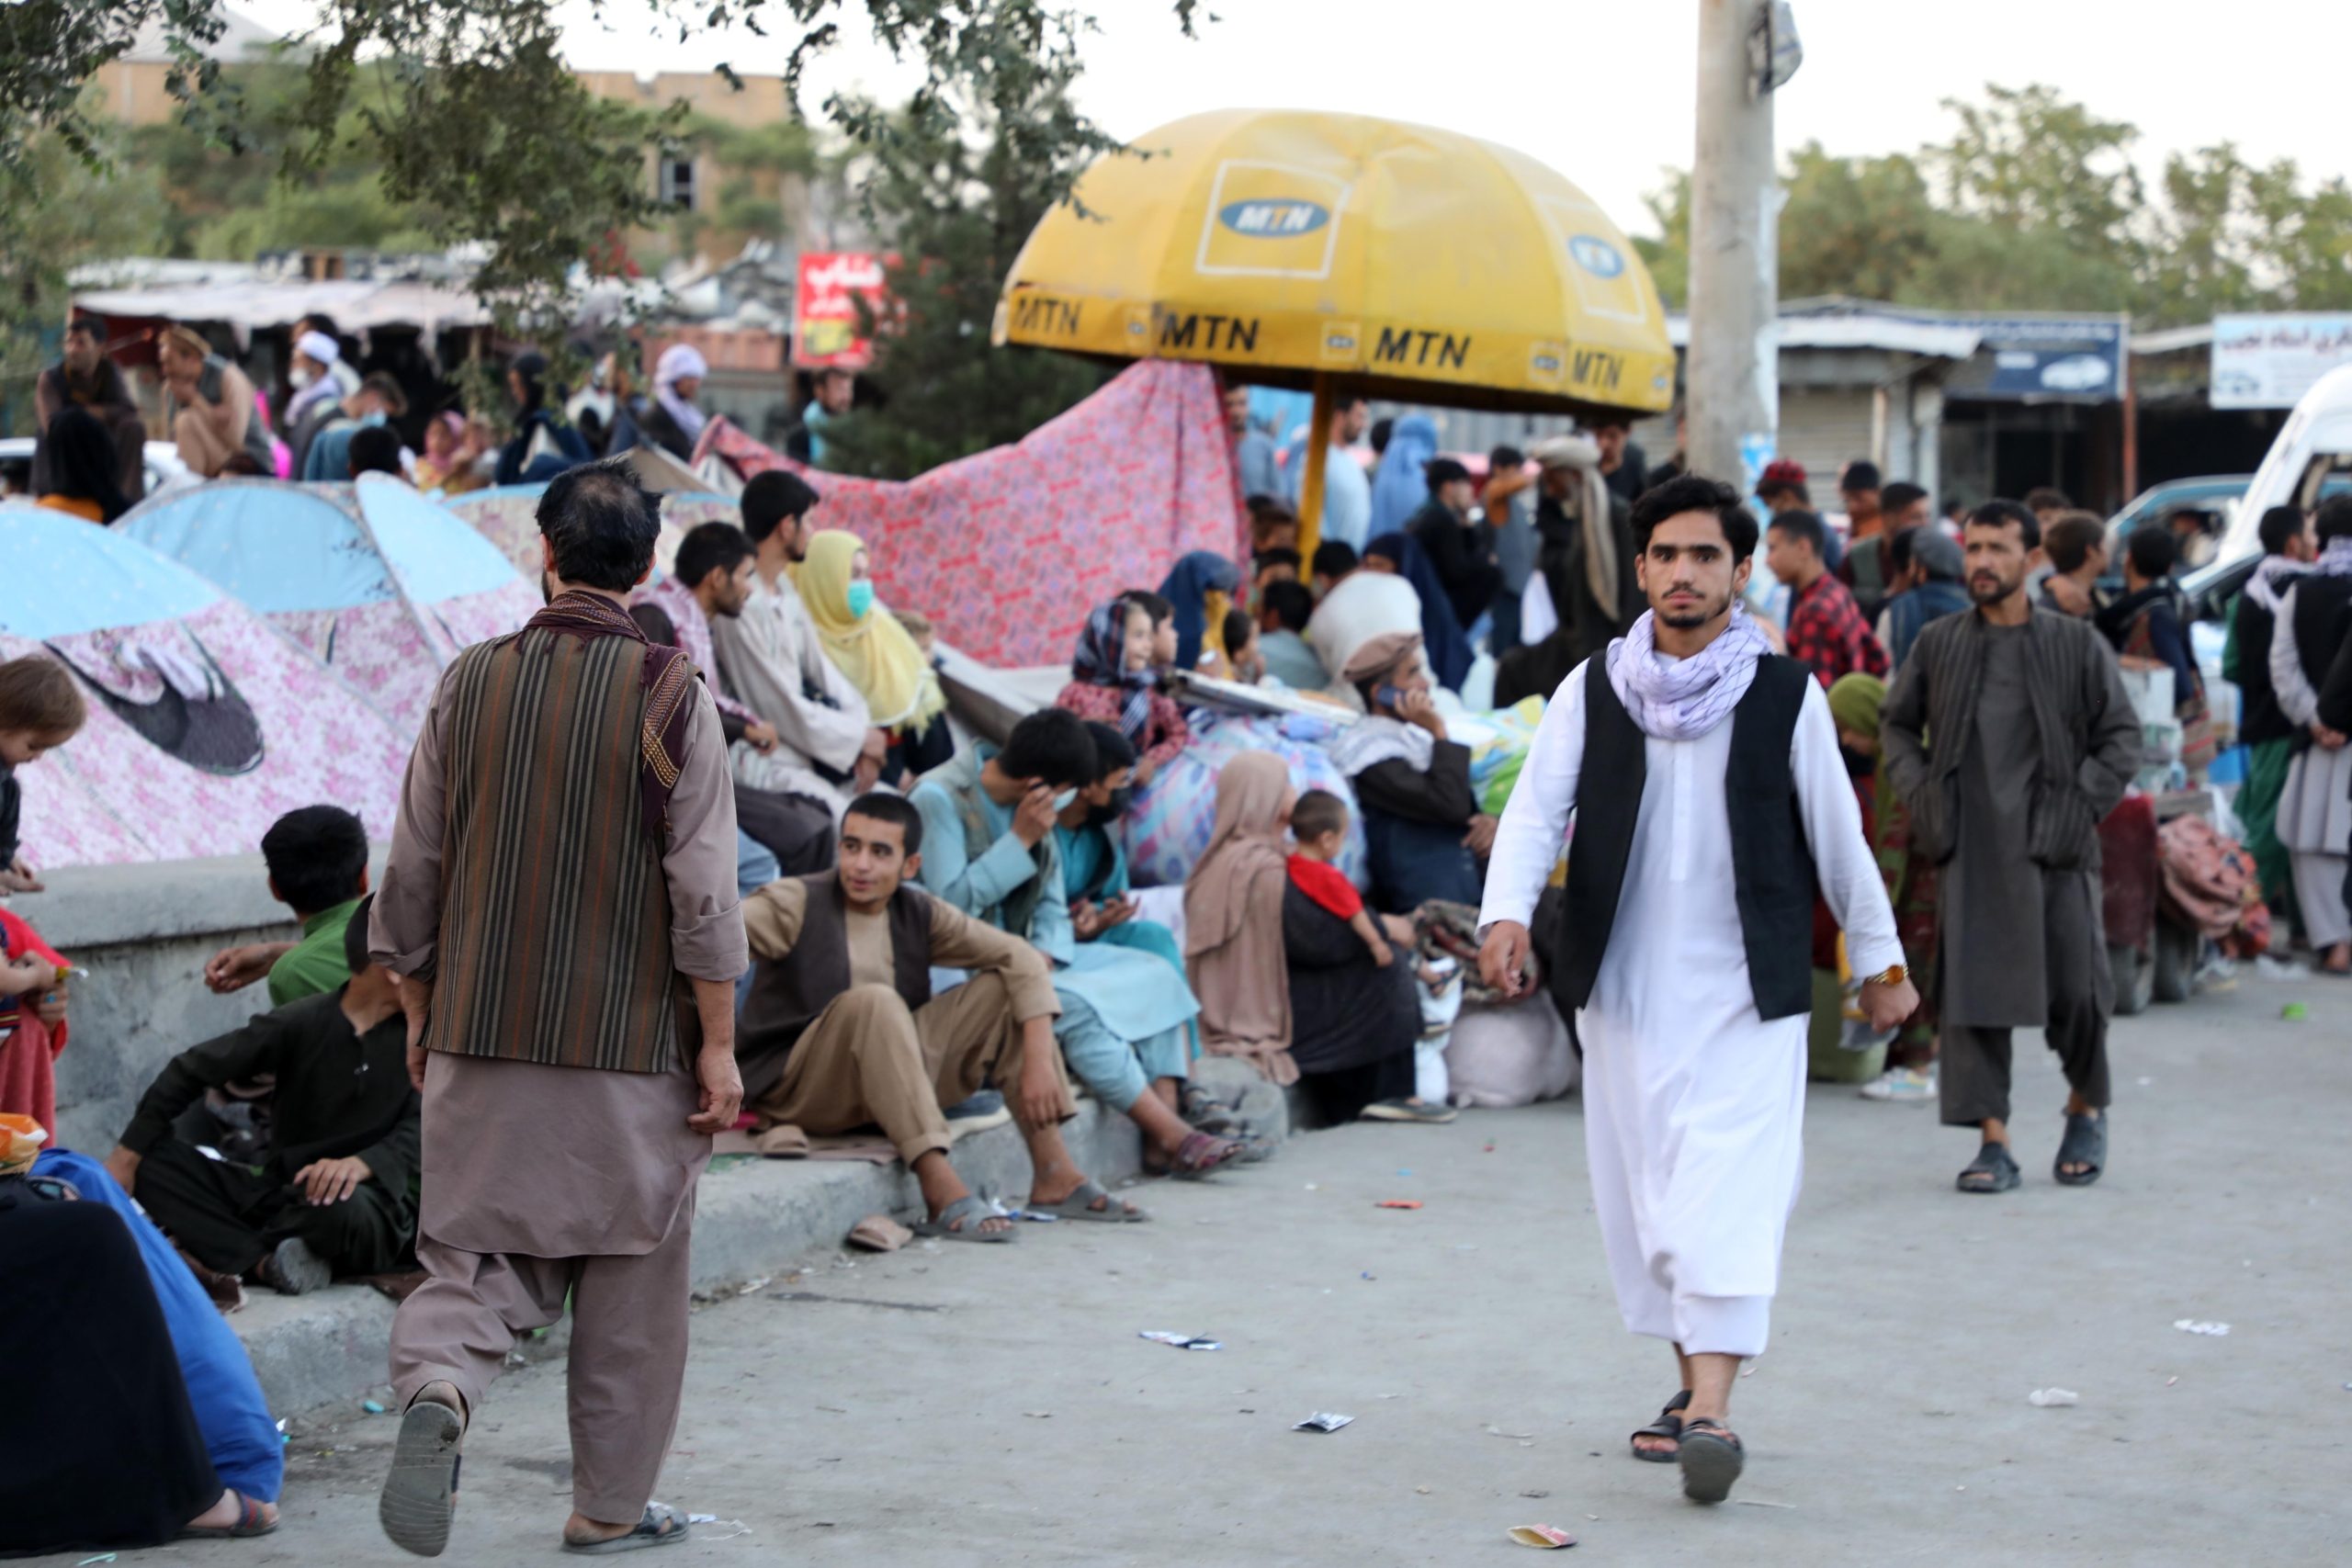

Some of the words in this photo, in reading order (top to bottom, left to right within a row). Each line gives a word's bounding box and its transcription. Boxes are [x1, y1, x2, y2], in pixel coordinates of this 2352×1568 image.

[1235, 203, 1314, 231] MTN
[1013, 297, 1082, 337] MTN
[1160, 313, 1260, 352] MTN
[1374, 326, 1472, 369] MTN
[1573, 349, 1624, 389] MTN
